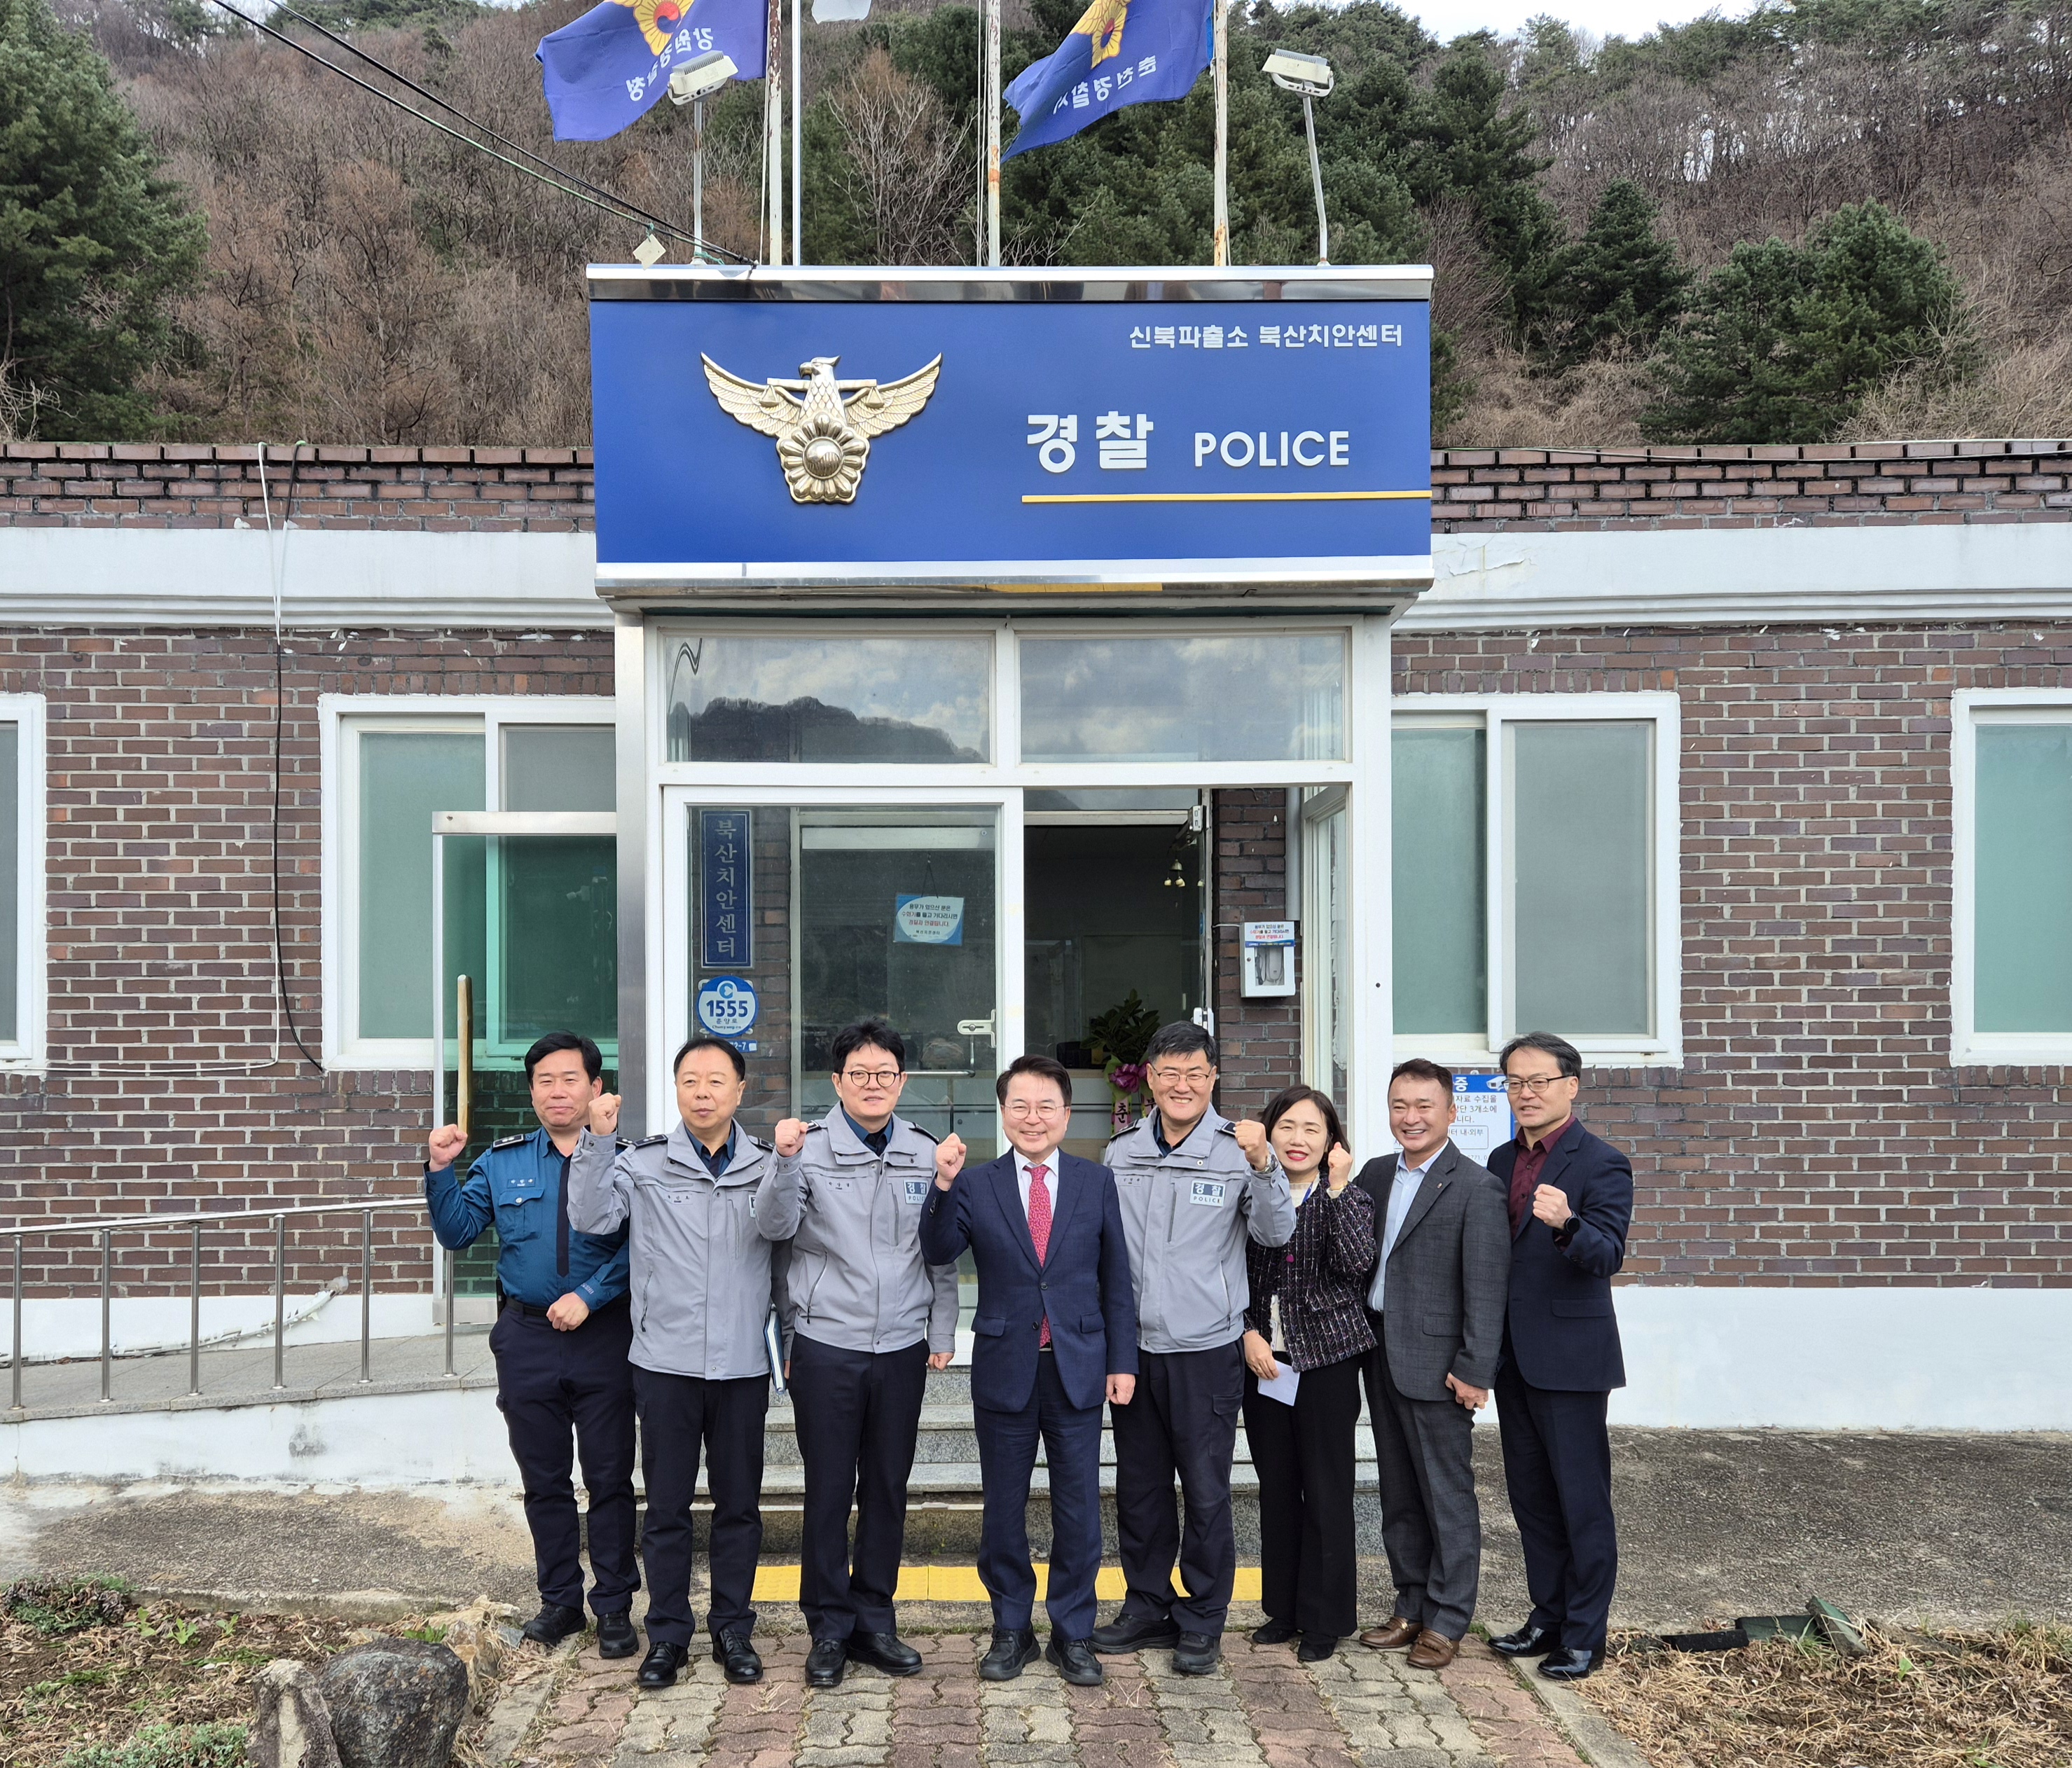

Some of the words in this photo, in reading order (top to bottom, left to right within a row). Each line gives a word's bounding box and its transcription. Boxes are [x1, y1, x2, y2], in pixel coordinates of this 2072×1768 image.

[1129, 324, 1248, 348] 신북파출소
[1259, 324, 1402, 347] 북산치안센터
[1027, 410, 1154, 473] 경찰
[1194, 430, 1350, 468] POLICE
[714, 819, 738, 959] 북산치안센터
[706, 1000, 748, 1017] 1555
[1453, 1095, 1471, 1103] 자료
[1195, 1183, 1221, 1196] 경찰
